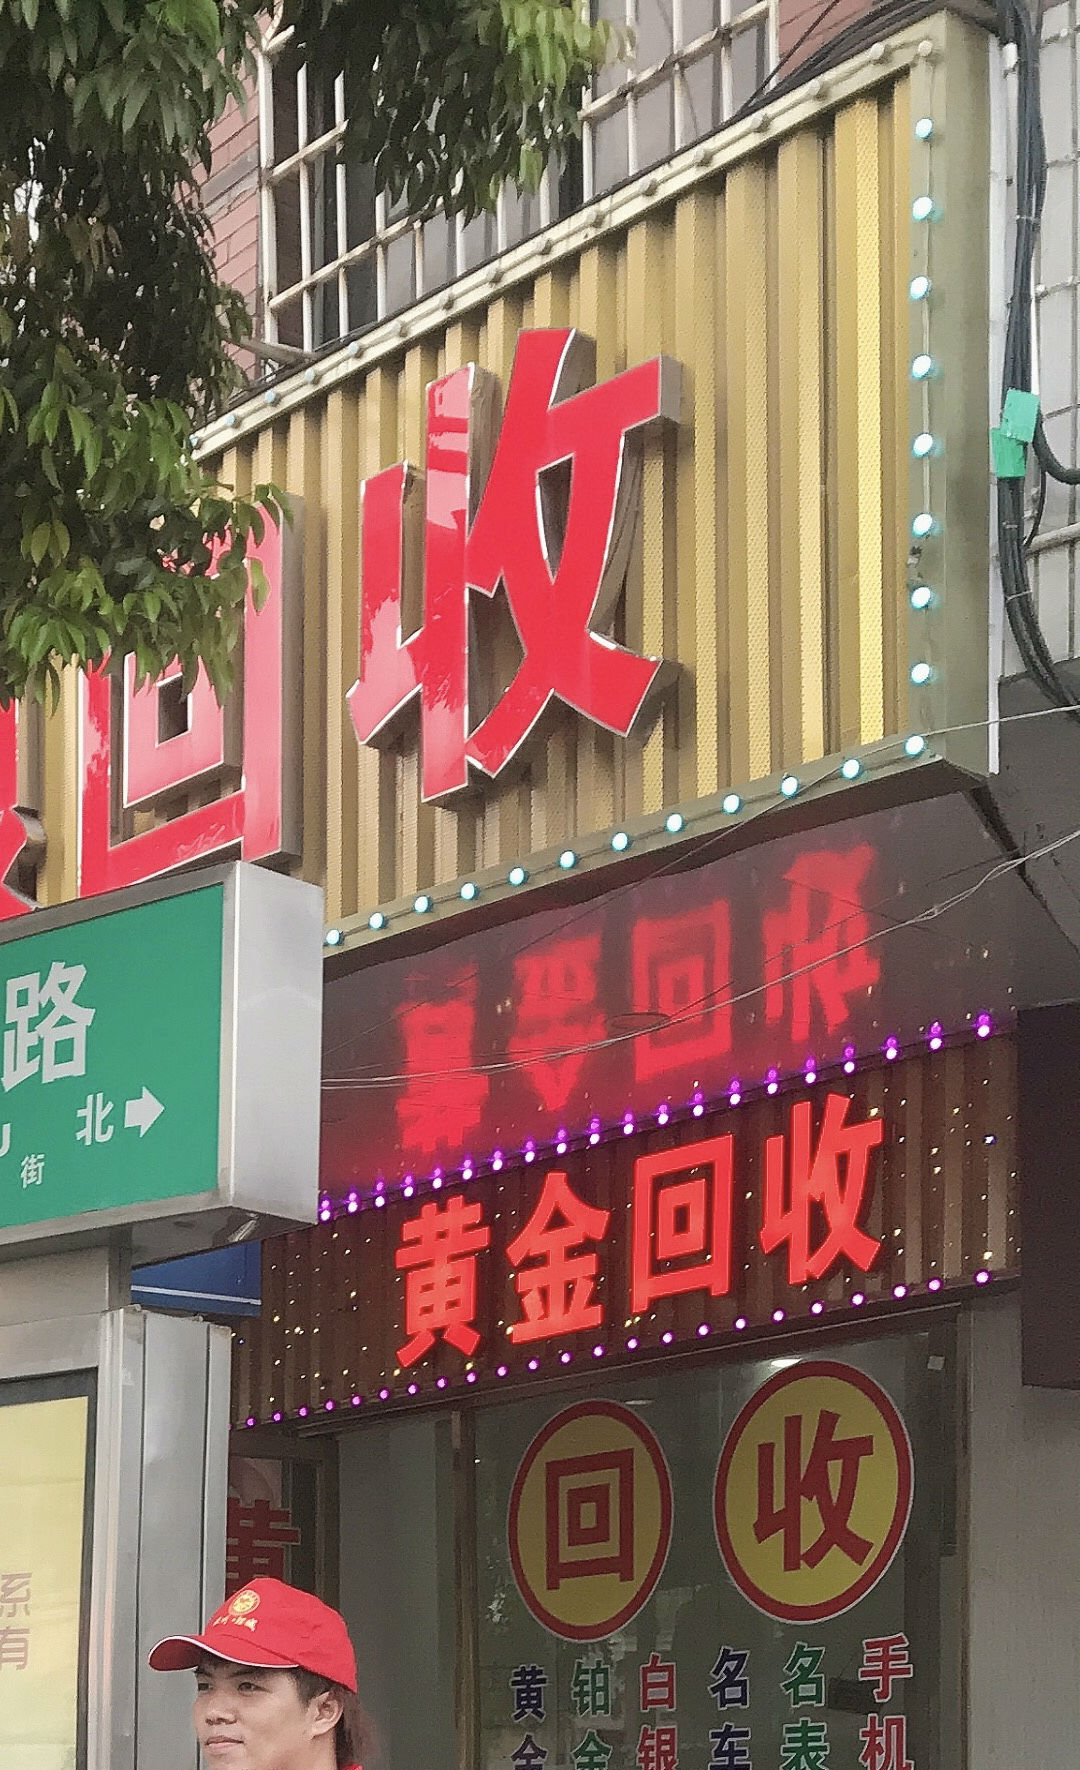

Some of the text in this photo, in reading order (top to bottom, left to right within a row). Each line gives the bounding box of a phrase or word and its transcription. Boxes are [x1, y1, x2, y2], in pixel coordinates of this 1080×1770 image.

[77, 1093, 115, 1146] 北
[395, 1094, 883, 1367] 黄金回收
